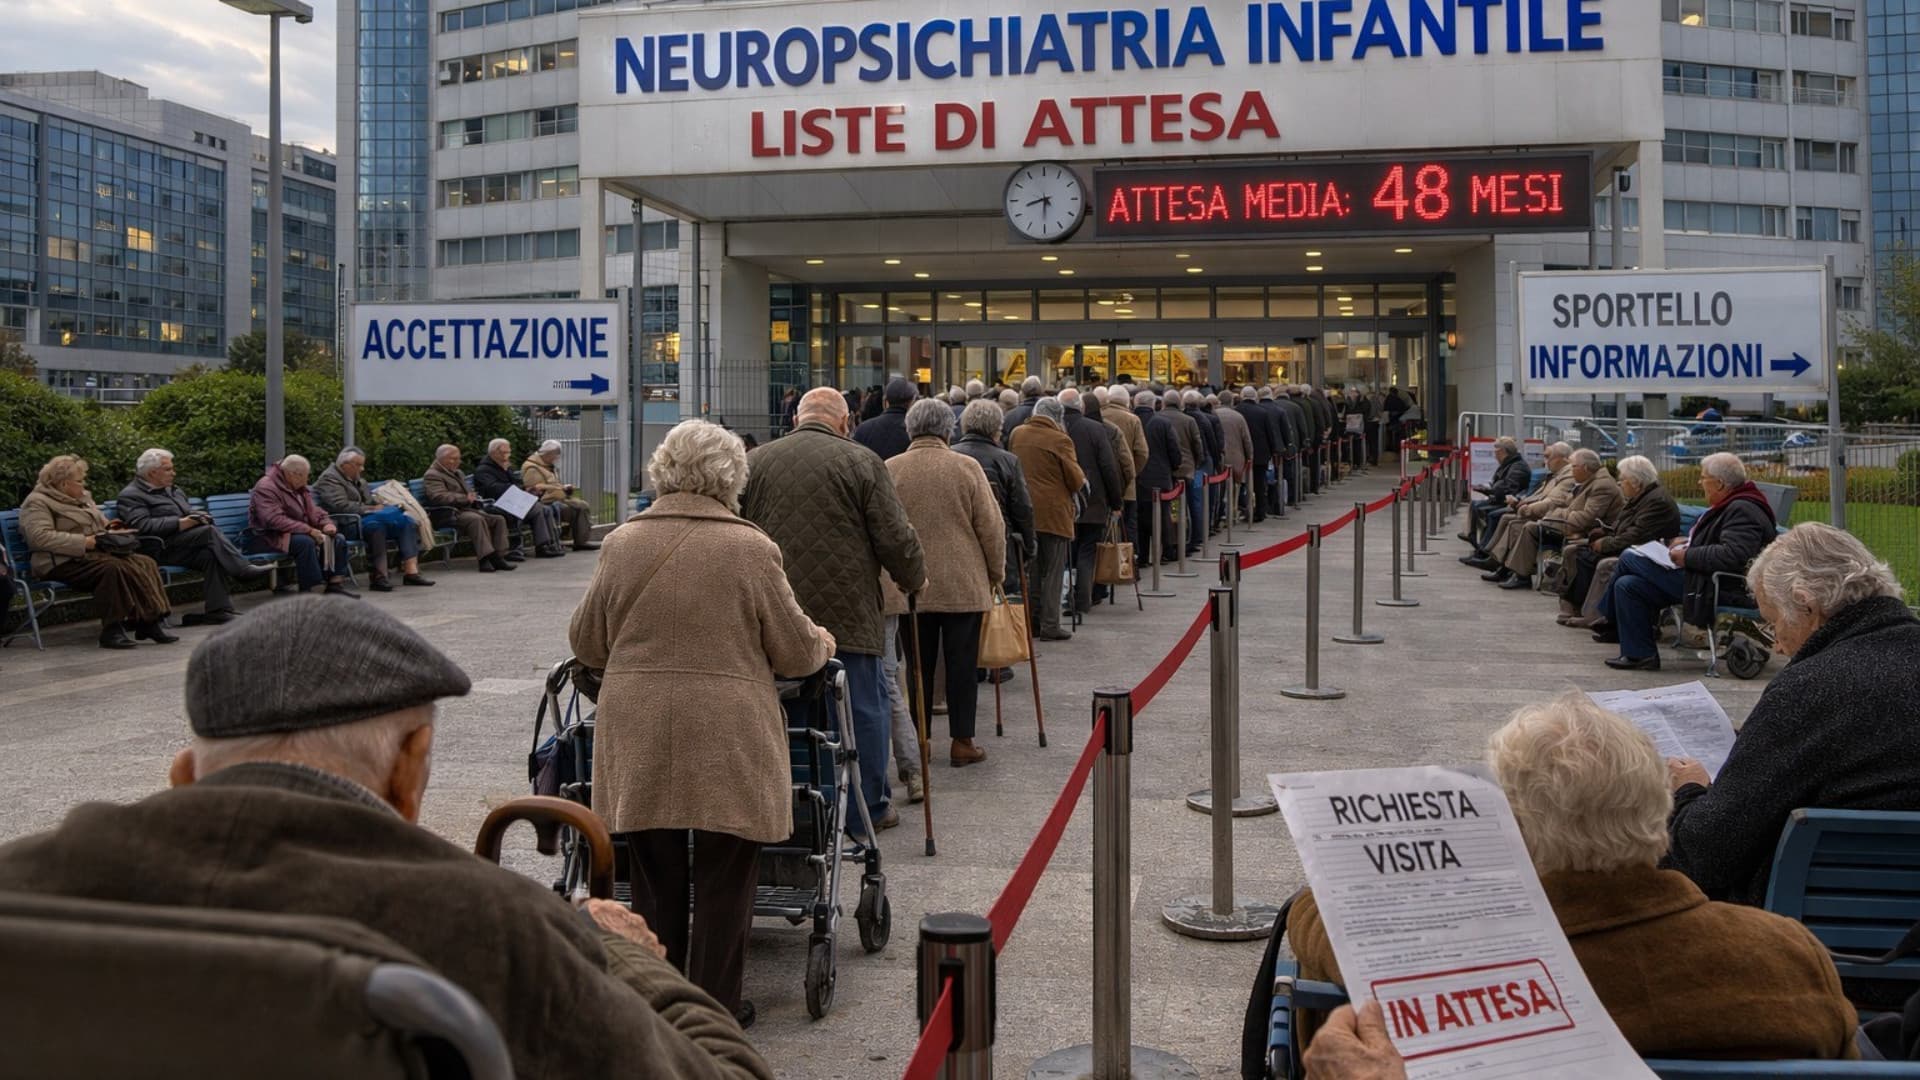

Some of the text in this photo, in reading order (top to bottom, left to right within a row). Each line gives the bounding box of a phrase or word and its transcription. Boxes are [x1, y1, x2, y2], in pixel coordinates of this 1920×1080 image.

[615, 0, 1604, 94] NEUROPSICHIATRIA INFANTILE
[751, 90, 1280, 157] LISTE DI ATTESA
[1108, 164, 1563, 223] ATTESA MEDIA: 48 MESI
[1552, 291, 1733, 329] SPORTELLO
[362, 317, 608, 360] ACCETTAZIONE
[1529, 343, 1763, 379] INFORMAZIONI
[1329, 790, 1480, 825] RICHIESTA
[1364, 840, 1462, 874] VISITA
[1387, 979, 1557, 1039] IN ATTESA
